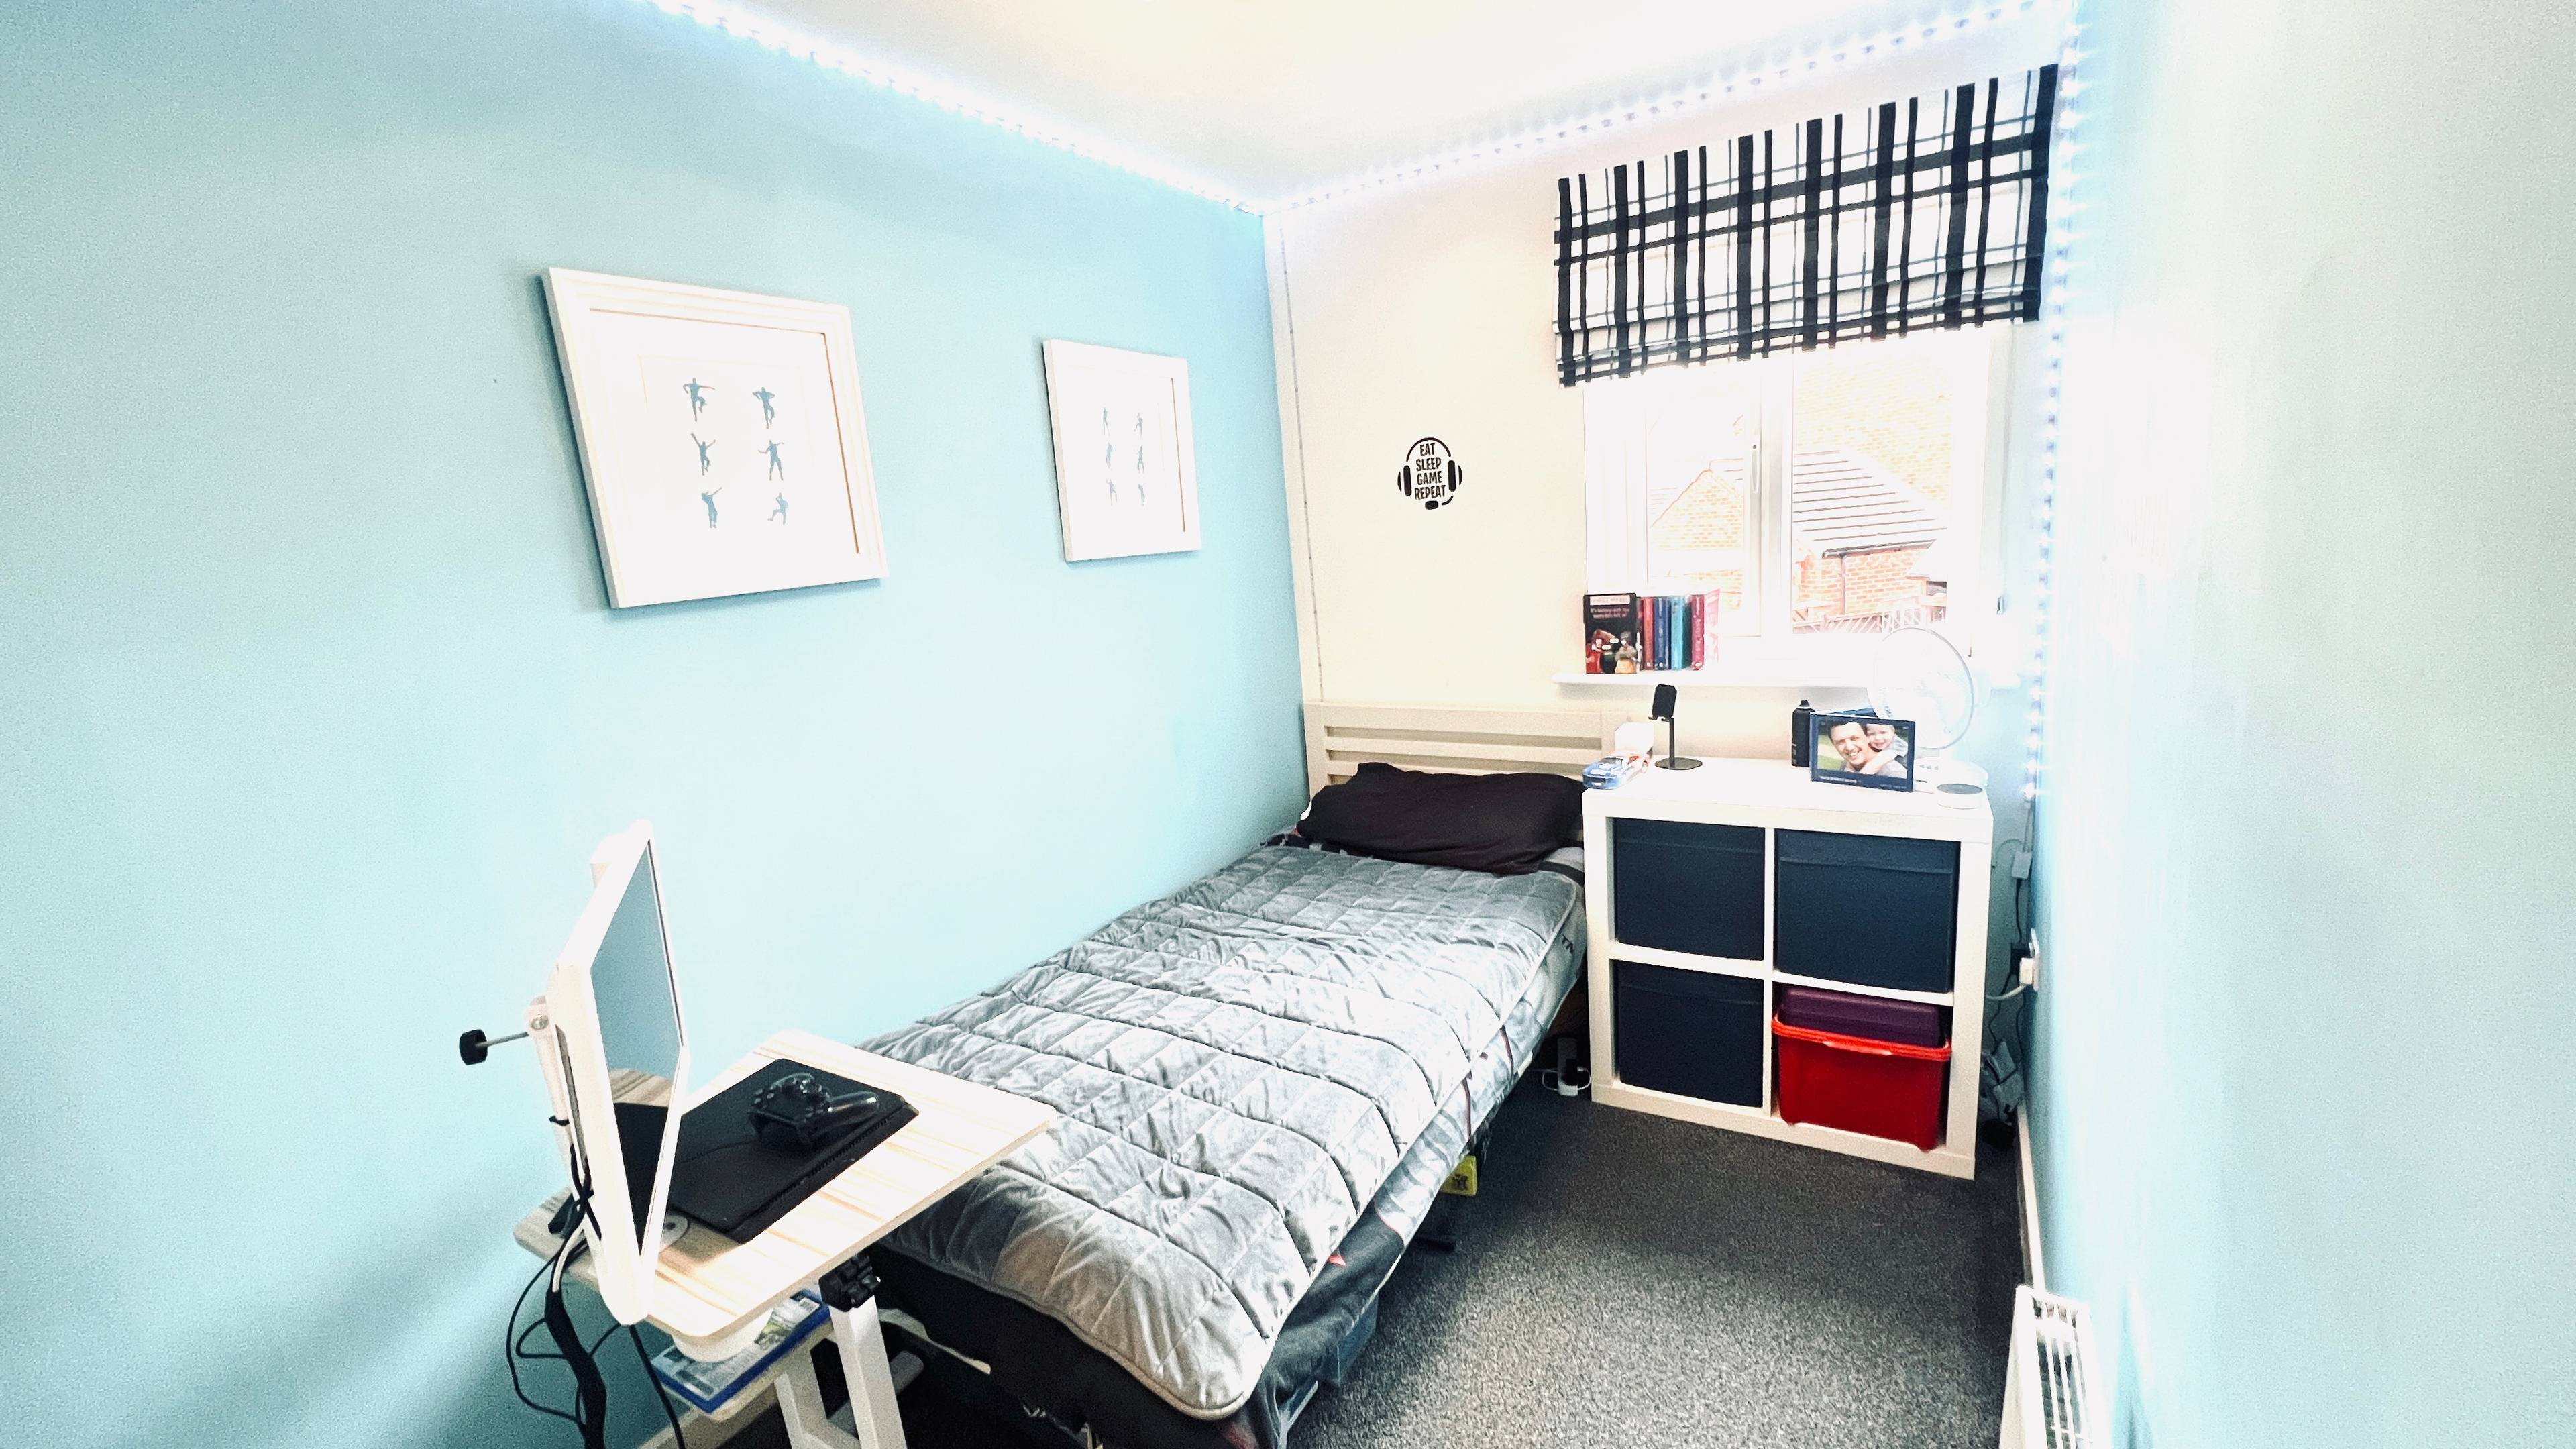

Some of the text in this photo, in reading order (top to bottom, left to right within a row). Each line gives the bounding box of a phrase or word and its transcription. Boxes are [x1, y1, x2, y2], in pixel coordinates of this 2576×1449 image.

[1419, 443, 1435, 456] EAT
[1415, 457, 1441, 471] SLEEP
[1417, 471, 1442, 485] GAME
[1414, 484, 1446, 500] REPEAT
